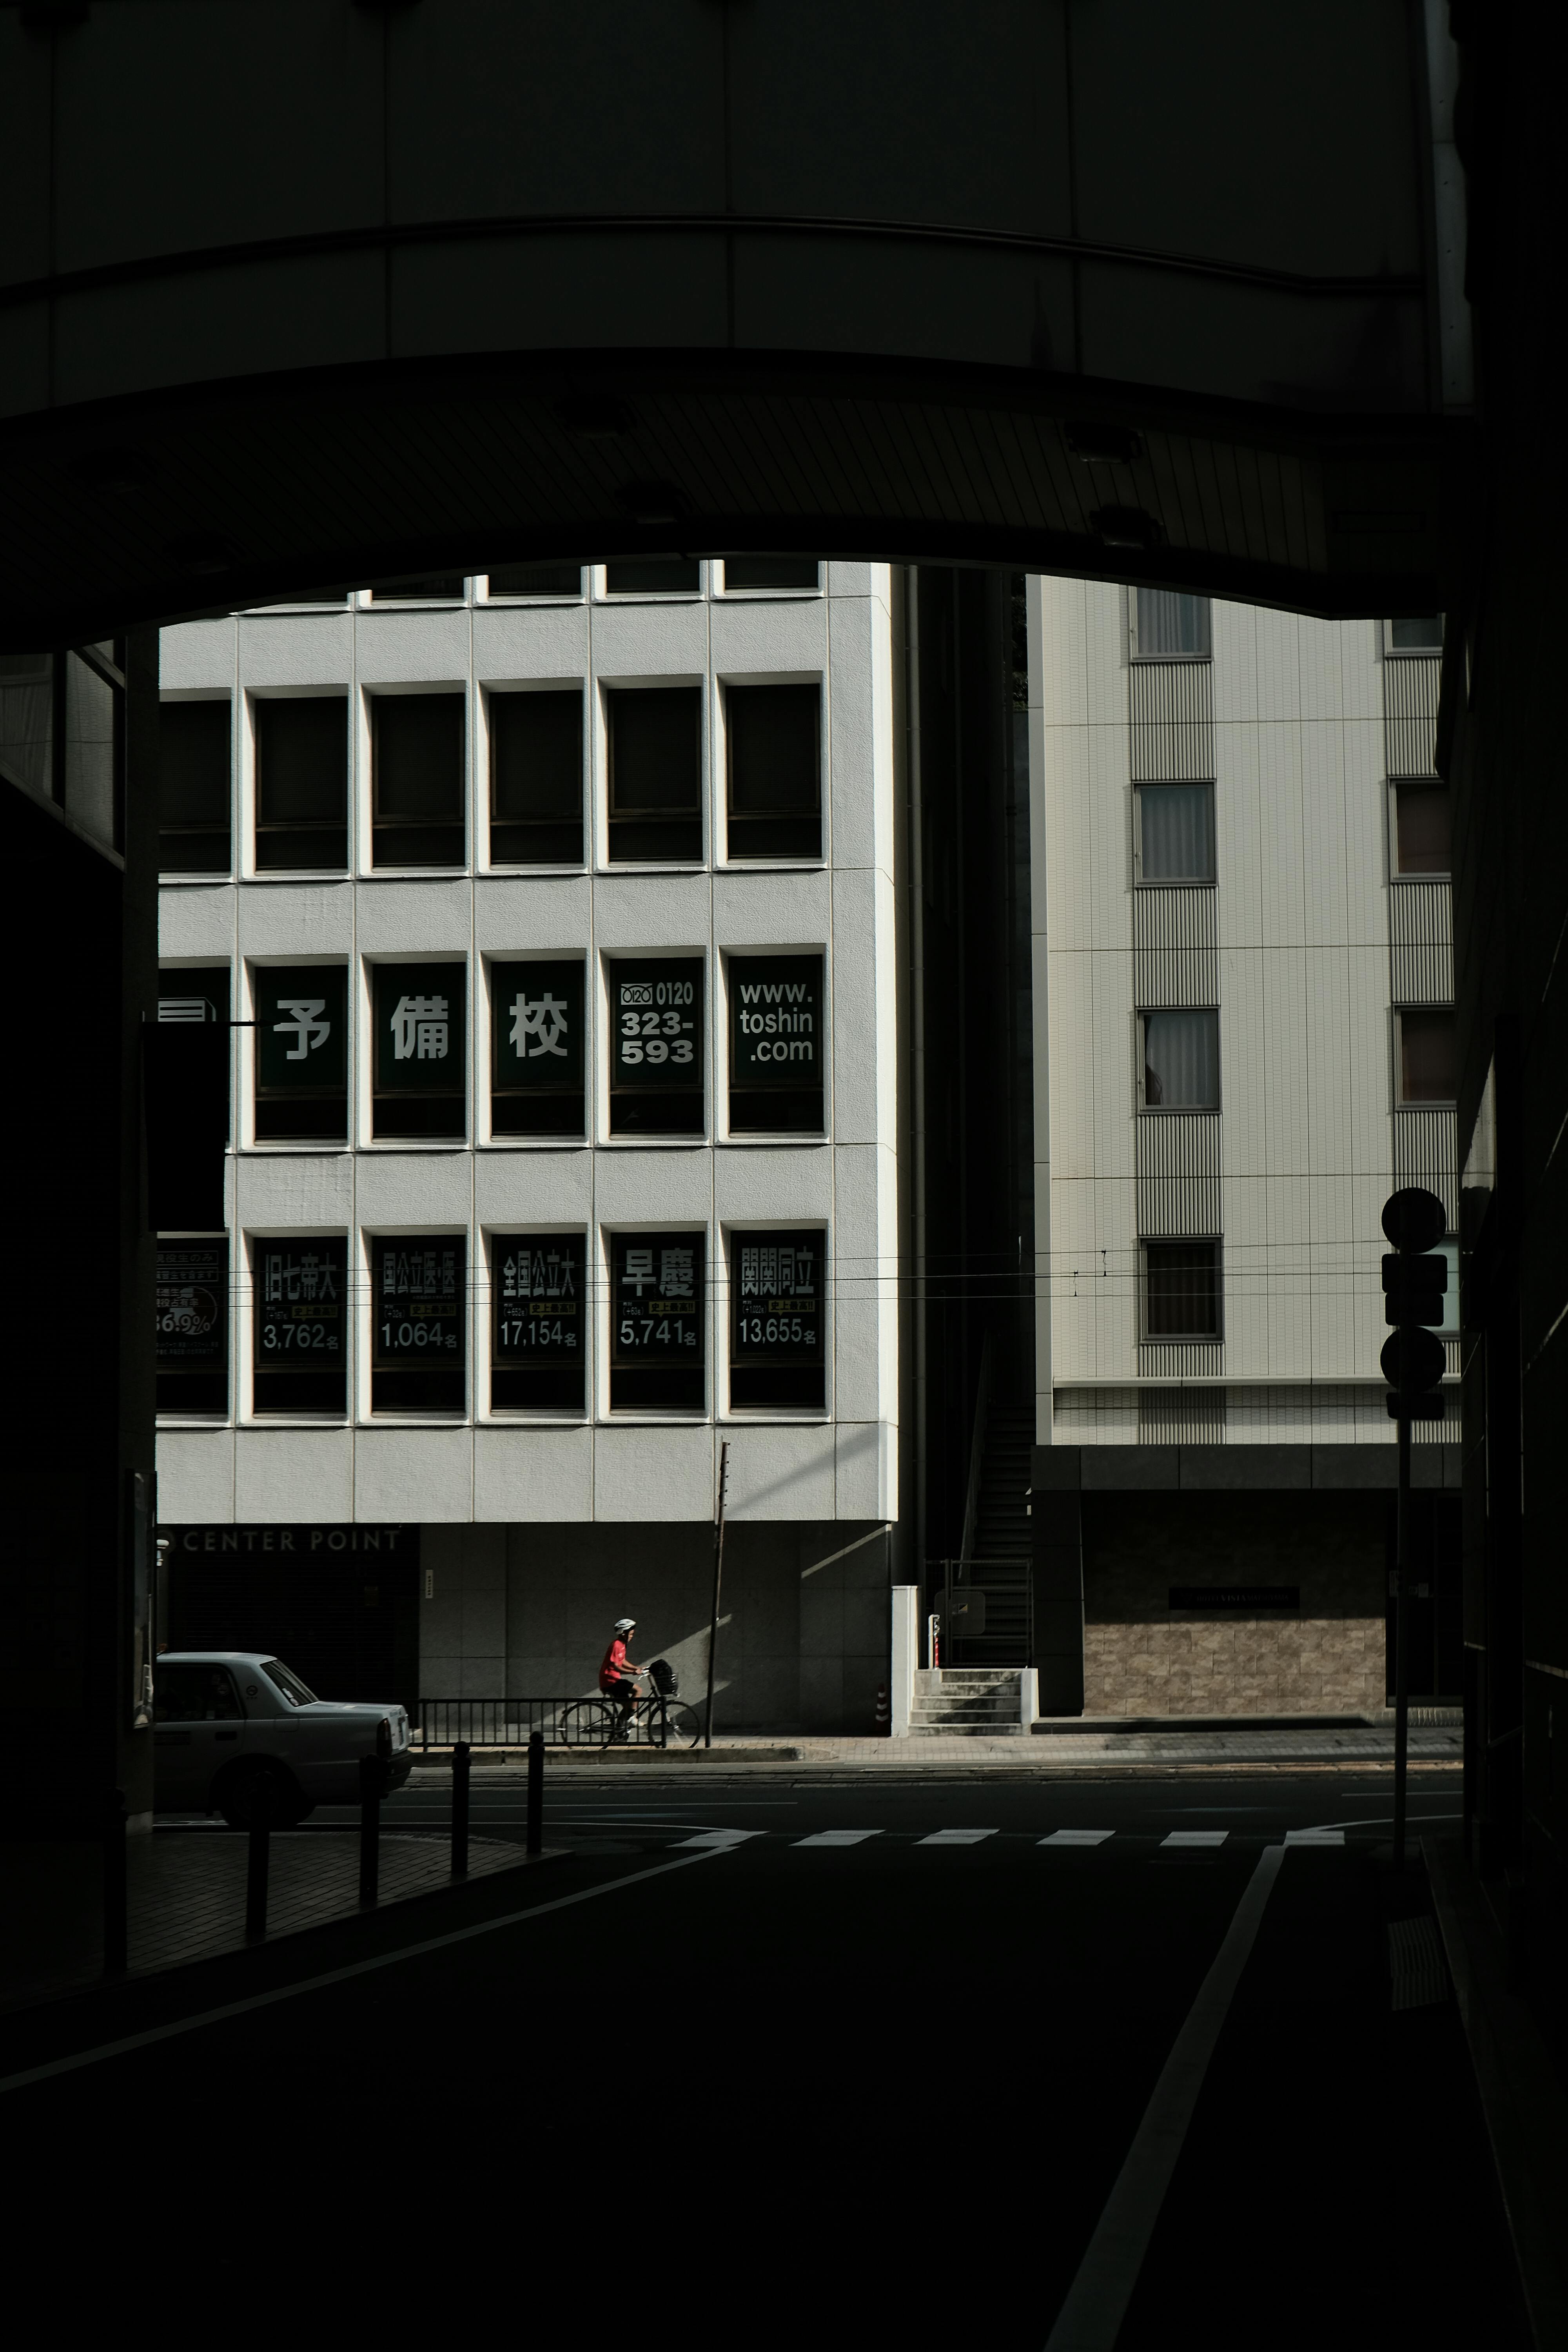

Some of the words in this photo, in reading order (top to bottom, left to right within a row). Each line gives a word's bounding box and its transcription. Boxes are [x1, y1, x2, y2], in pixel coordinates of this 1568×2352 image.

[656, 982, 693, 1005] 0120
[740, 984, 813, 1003] www.
[621, 1011, 694, 1036] 323-
[740, 1007, 813, 1034] toshin
[621, 1040, 694, 1064] 593
[751, 1041, 813, 1061] .com
[265, 1252, 337, 1301] 旧七帝大
[503, 1249, 575, 1298] 全国公立大
[622, 1247, 694, 1297] 早慶
[741, 1245, 814, 1296] 関関同立
[263, 1324, 339, 1350] 3,762名
[381, 1322, 457, 1348] 1,064名
[501, 1321, 577, 1347] 17,154名
[620, 1319, 696, 1346] 5,741名
[740, 1318, 816, 1345] 13,655名
[183, 1530, 296, 1552] CENTER
[310, 1530, 401, 1551] POINT
